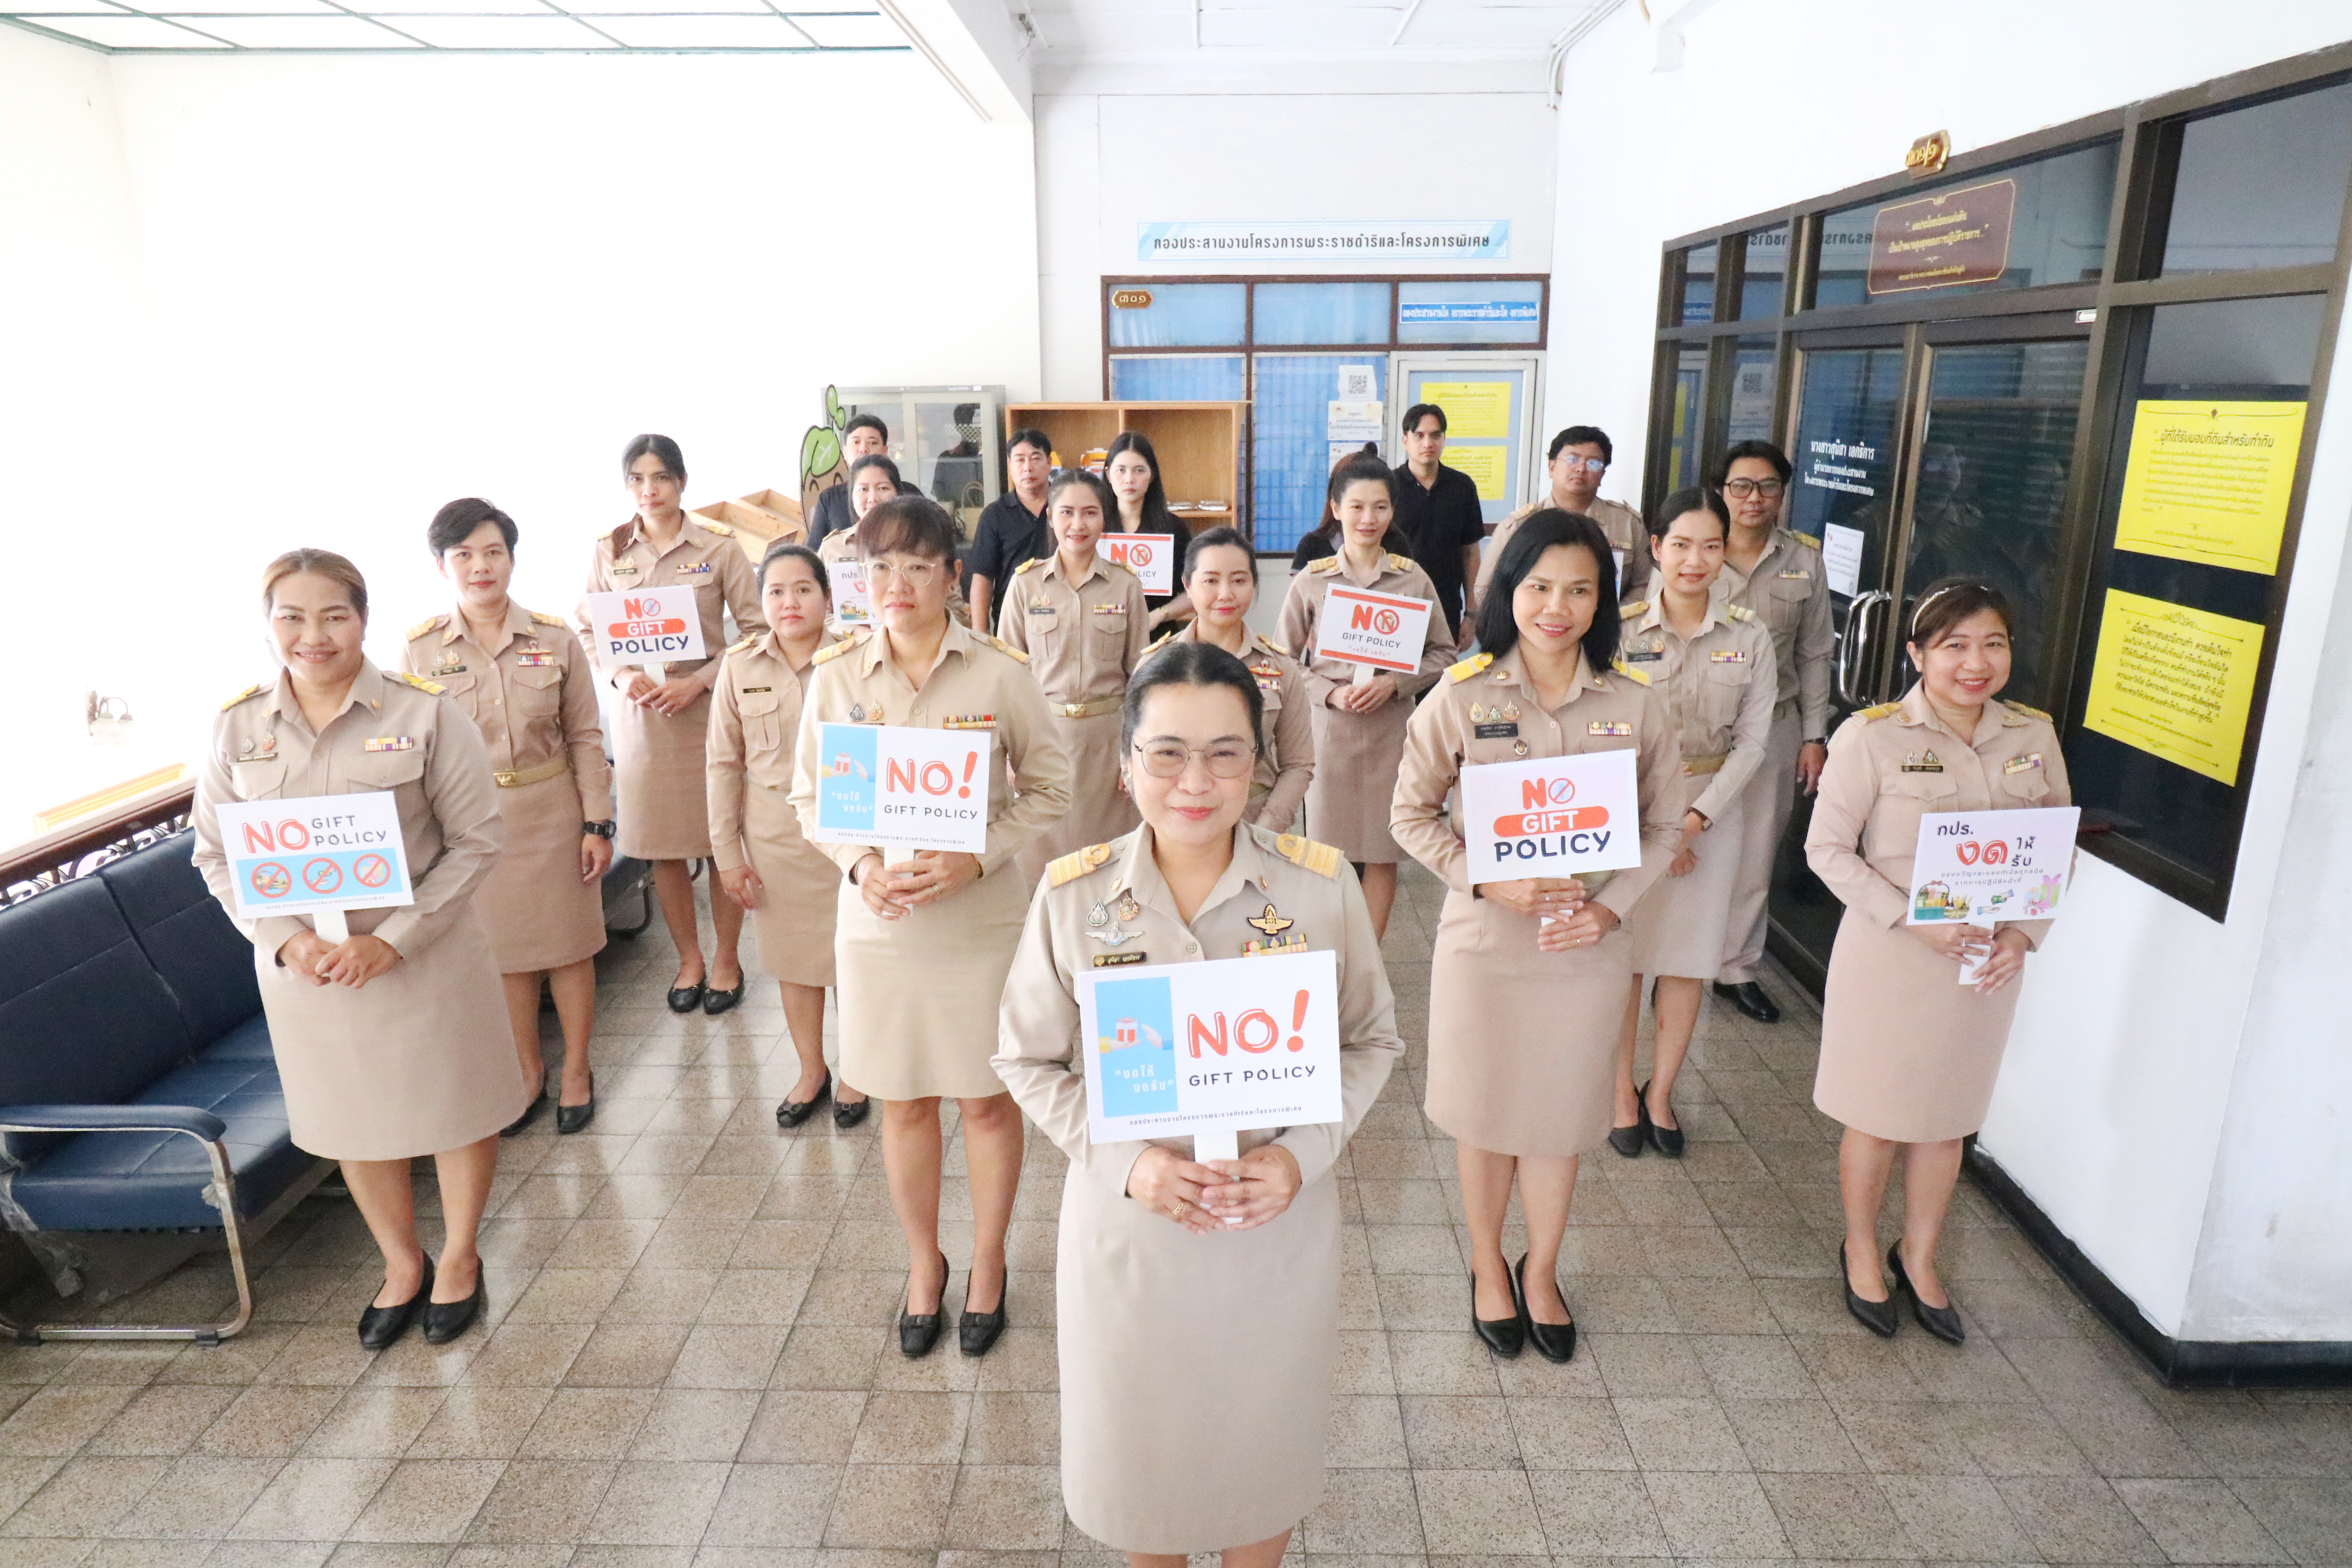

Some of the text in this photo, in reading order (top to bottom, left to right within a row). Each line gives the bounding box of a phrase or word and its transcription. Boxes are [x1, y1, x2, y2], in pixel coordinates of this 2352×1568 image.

[1154, 233, 1490, 249] กองประสานงานโครงการพระราชดำริและโครงการพิเศษ
[1119, 295, 1146, 304] ๓๐๑
[627, 621, 665, 636] GIFT
[610, 636, 688, 655] POLICY
[1342, 632, 1402, 649] GIFT POLICY
[886, 751, 978, 799] NO!
[884, 805, 978, 819] GIFT POLICY
[1522, 810, 1579, 834] GIFT
[1938, 821, 1974, 836] กปร.
[242, 815, 355, 854] NO GIFT
[314, 830, 387, 846] POLICY
[1494, 831, 1611, 863] POLICY
[1956, 839, 2008, 866] งด
[2011, 854, 2031, 867] รับ
[1187, 989, 1309, 1059] NO!
[1189, 1064, 1316, 1087] GIFT POLICY
